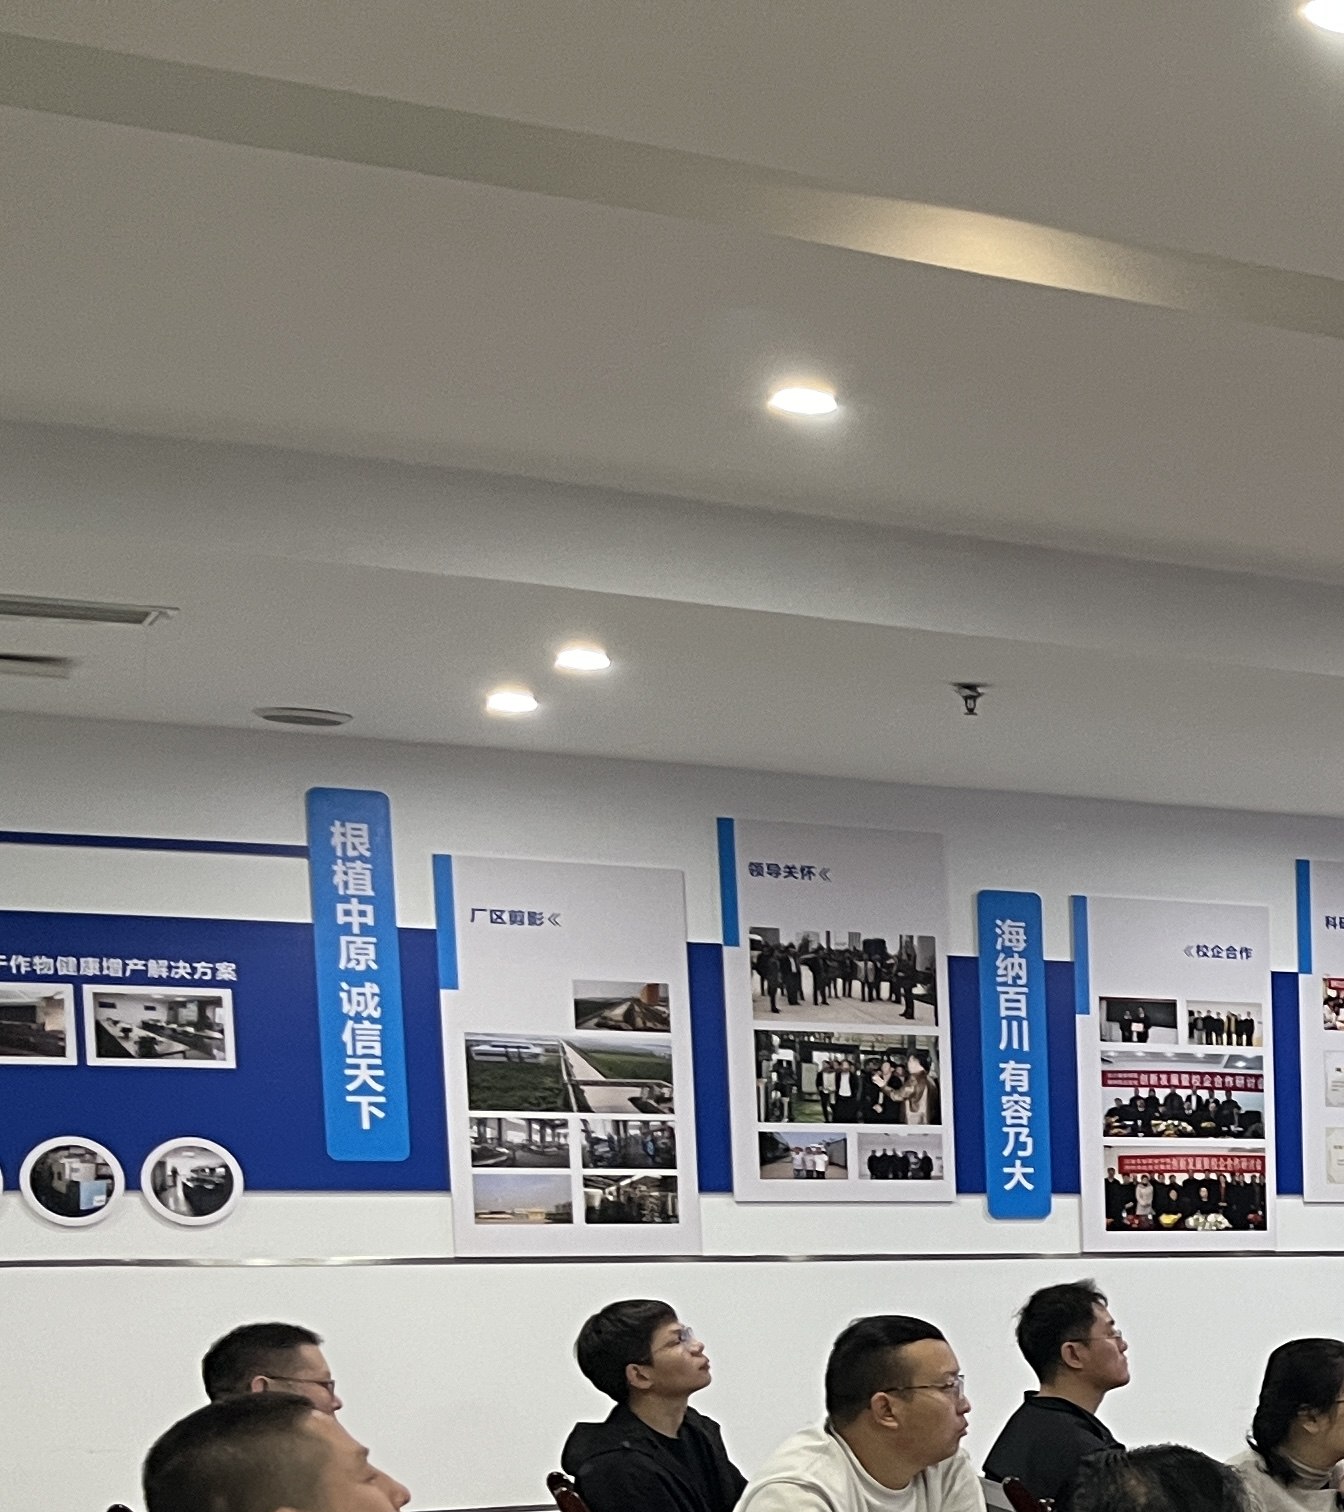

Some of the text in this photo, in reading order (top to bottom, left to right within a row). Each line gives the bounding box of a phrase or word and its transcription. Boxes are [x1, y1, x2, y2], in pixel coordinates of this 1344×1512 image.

[748, 861, 816, 883] 领导关怀
[470, 908, 545, 928] 厂区剪影
[1195, 943, 1253, 961] 校企合作
[330, 821, 387, 1131] 根植中原 诚信天下
[994, 918, 1034, 1191] 海纳百川 有容乃大
